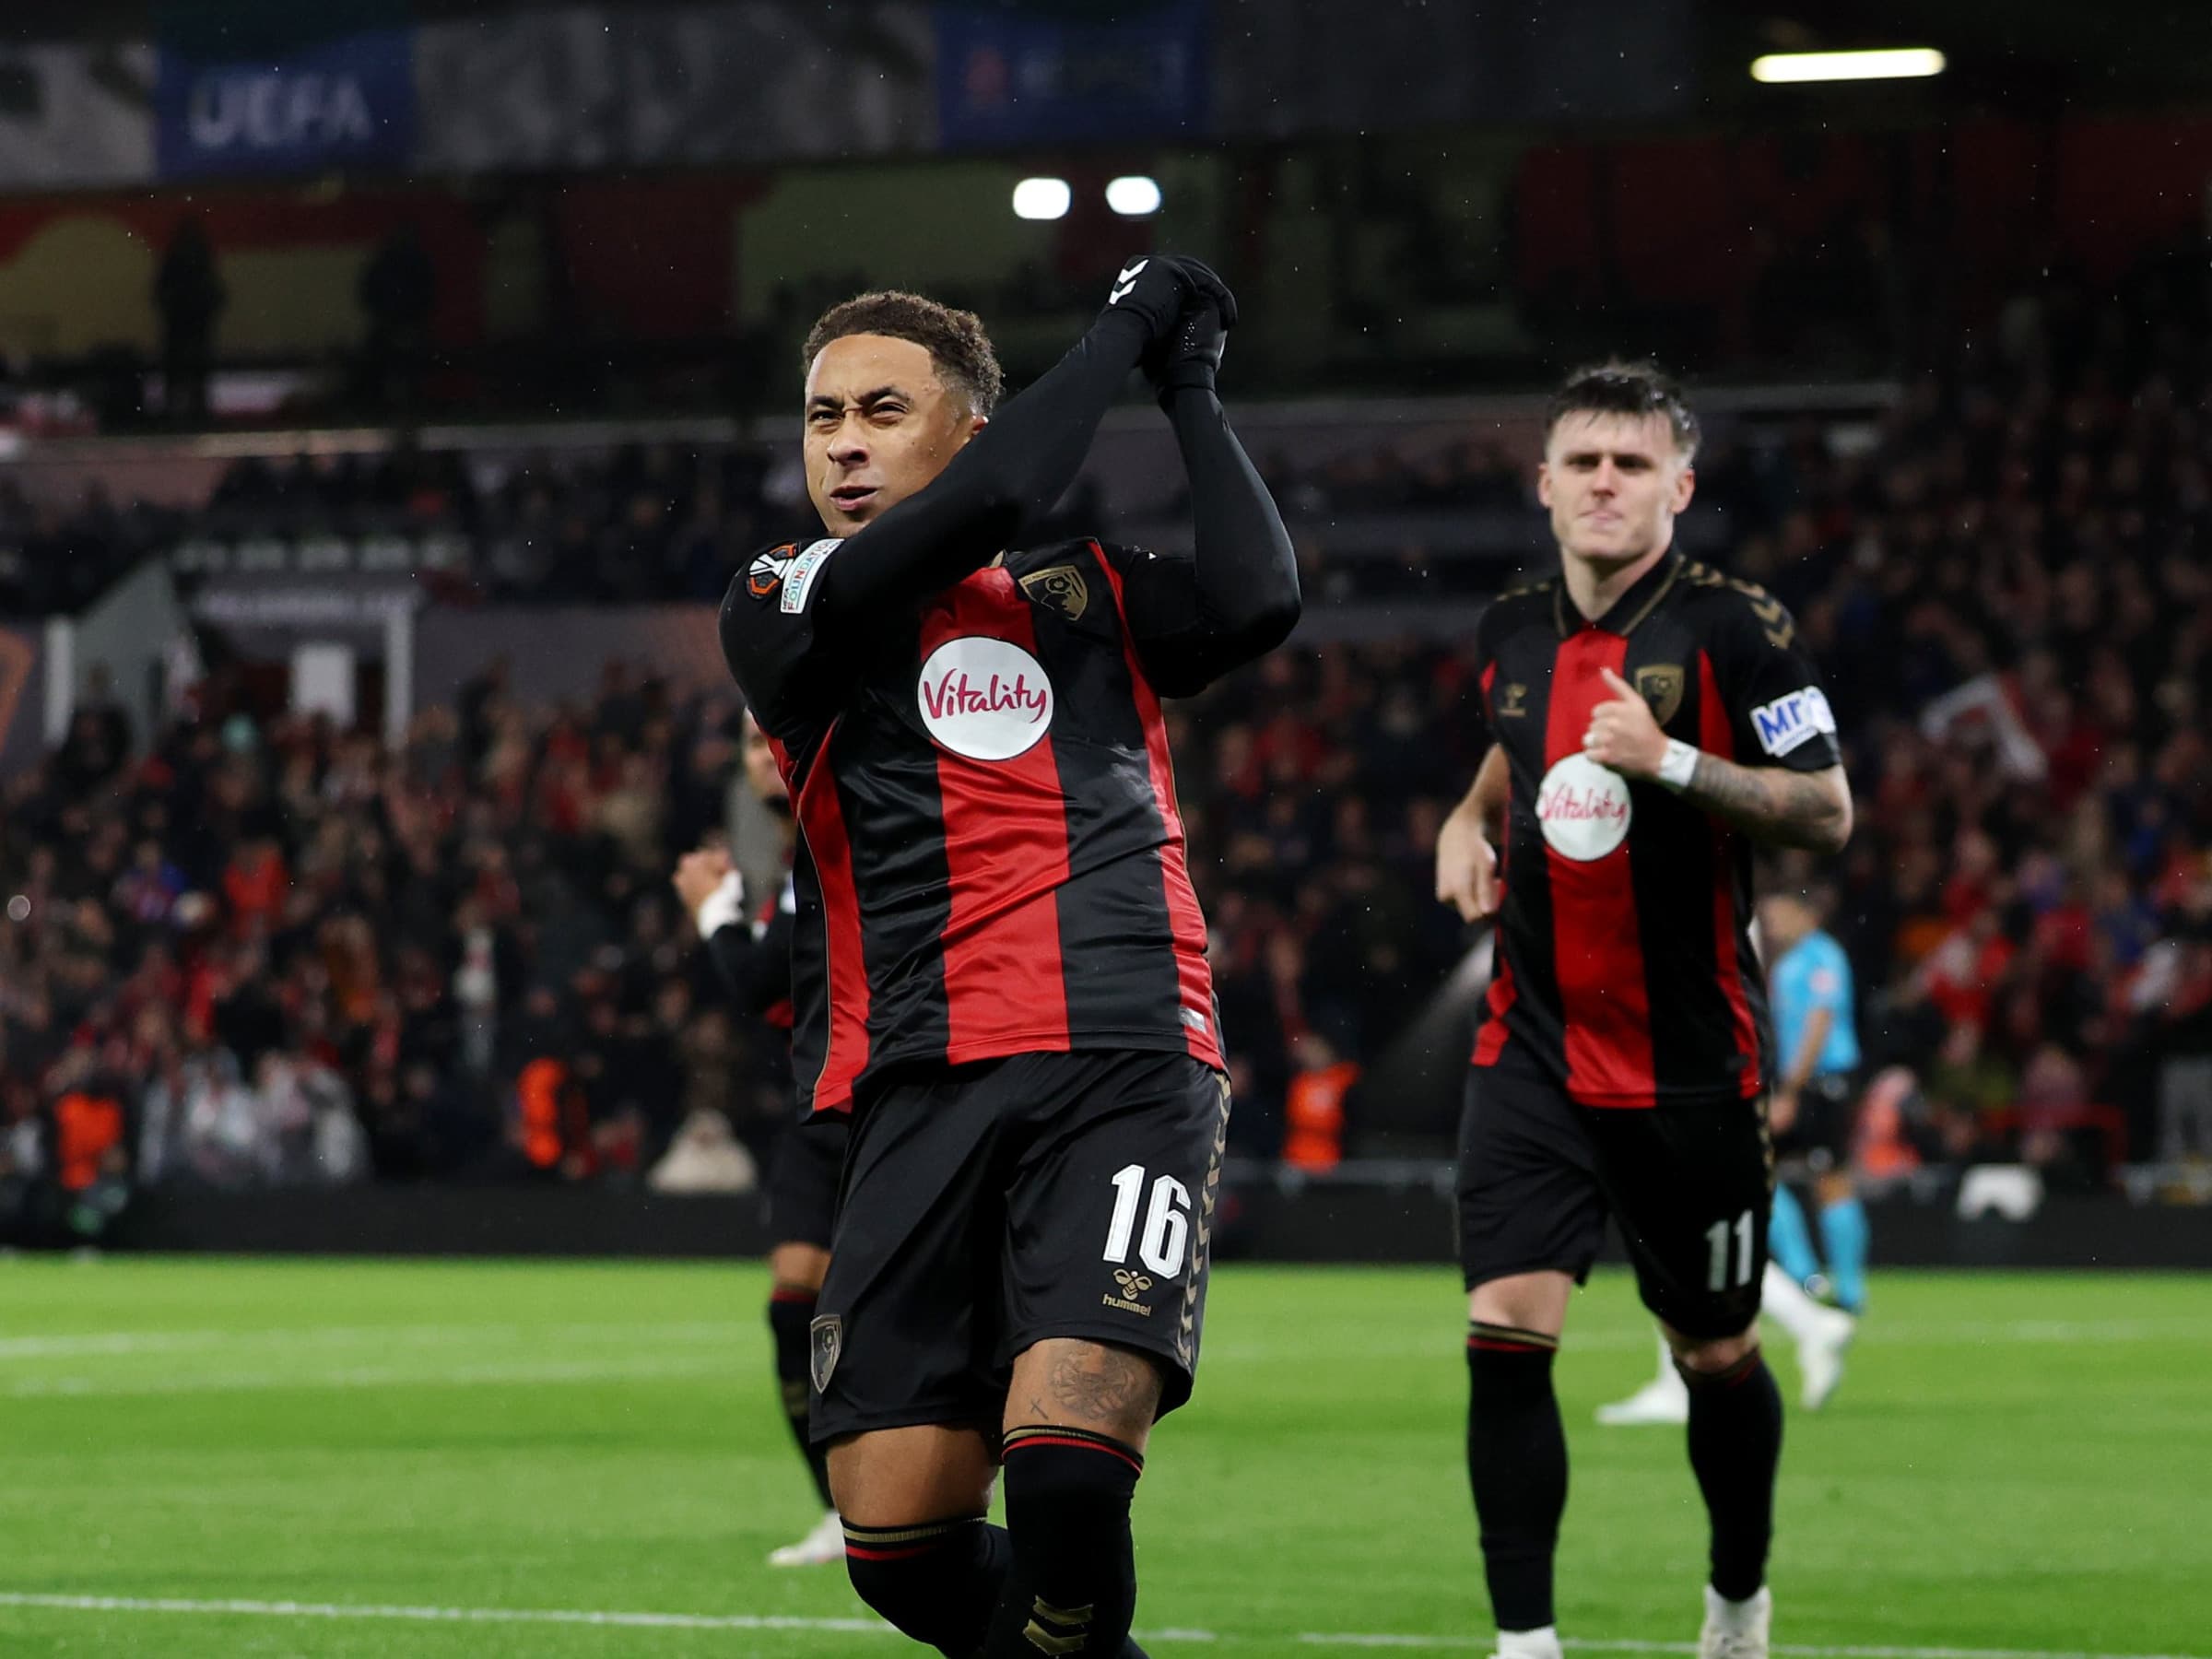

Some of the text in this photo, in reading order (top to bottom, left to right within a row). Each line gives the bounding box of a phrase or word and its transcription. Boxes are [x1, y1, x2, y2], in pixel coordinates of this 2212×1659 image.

[924, 667, 1047, 724] Vitality
[1542, 781, 1628, 830] Vitality
[1103, 1164, 1191, 1279] 16
[1704, 1209, 1754, 1291] 11
[1102, 1293, 1152, 1317] hummel
